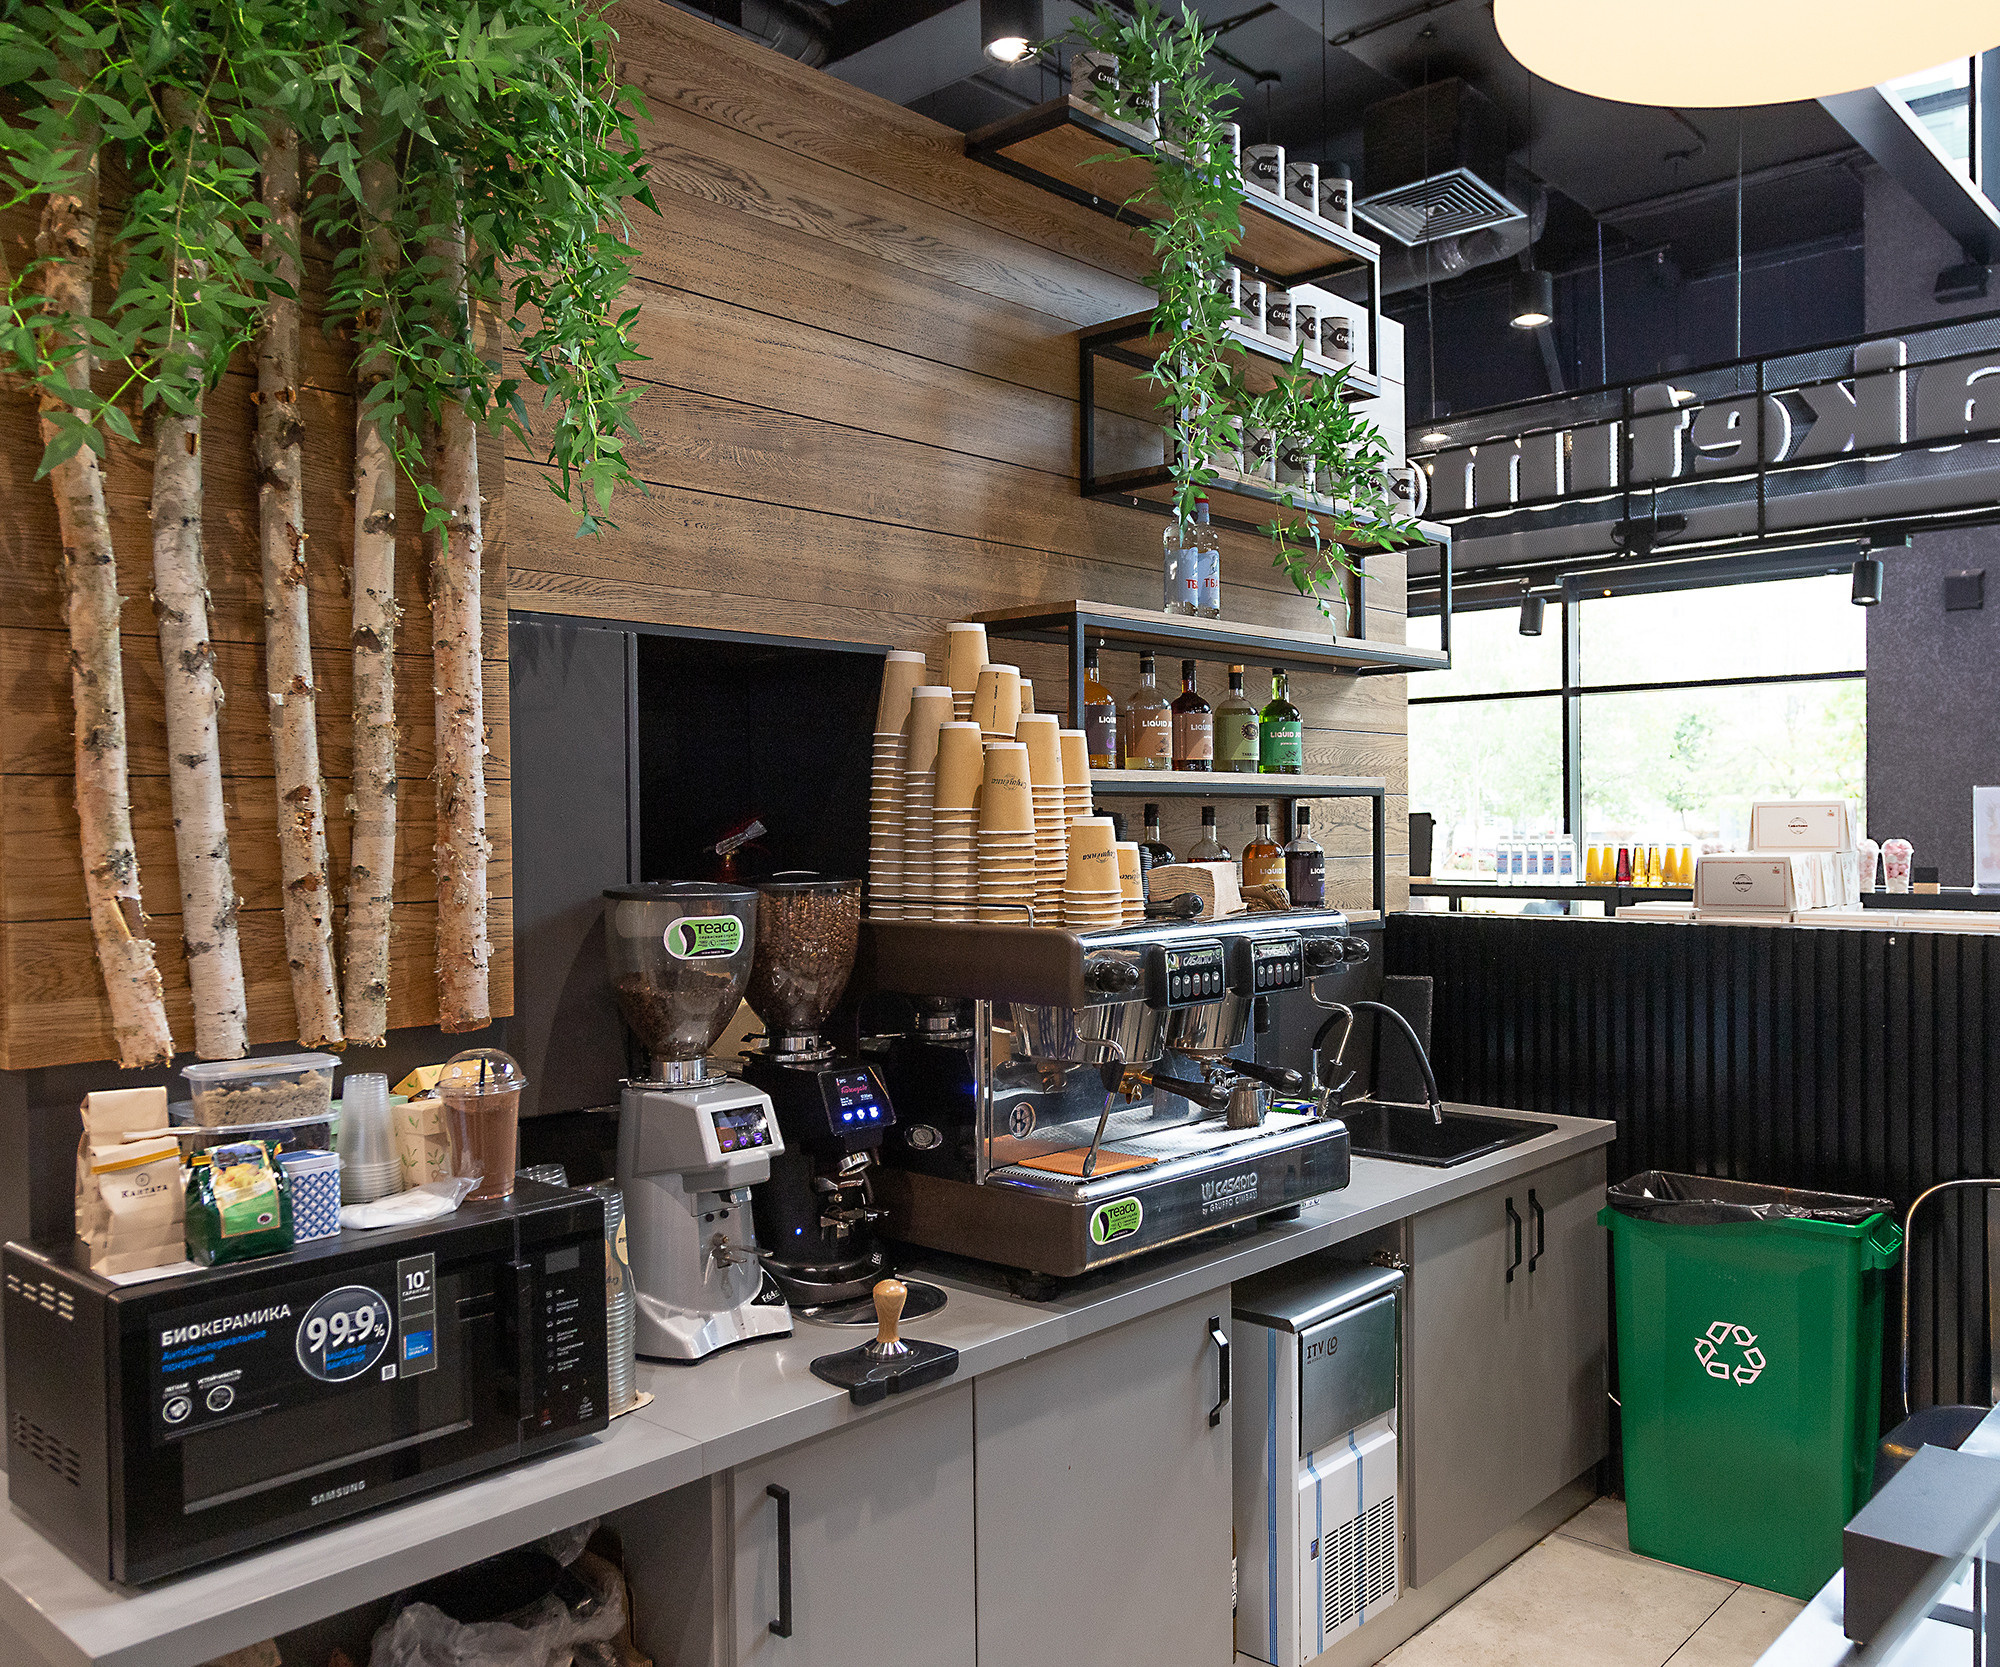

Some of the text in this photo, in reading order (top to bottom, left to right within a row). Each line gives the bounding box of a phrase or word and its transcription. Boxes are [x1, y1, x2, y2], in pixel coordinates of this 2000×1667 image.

[1270, 728, 1294, 738] LIQUID
[405, 1271, 425, 1290] 10
[161, 1303, 292, 1347] БИОКЕРАМИКА
[1307, 1340, 1324, 1359] ITV
[310, 1480, 367, 1506] SAMSUNG
